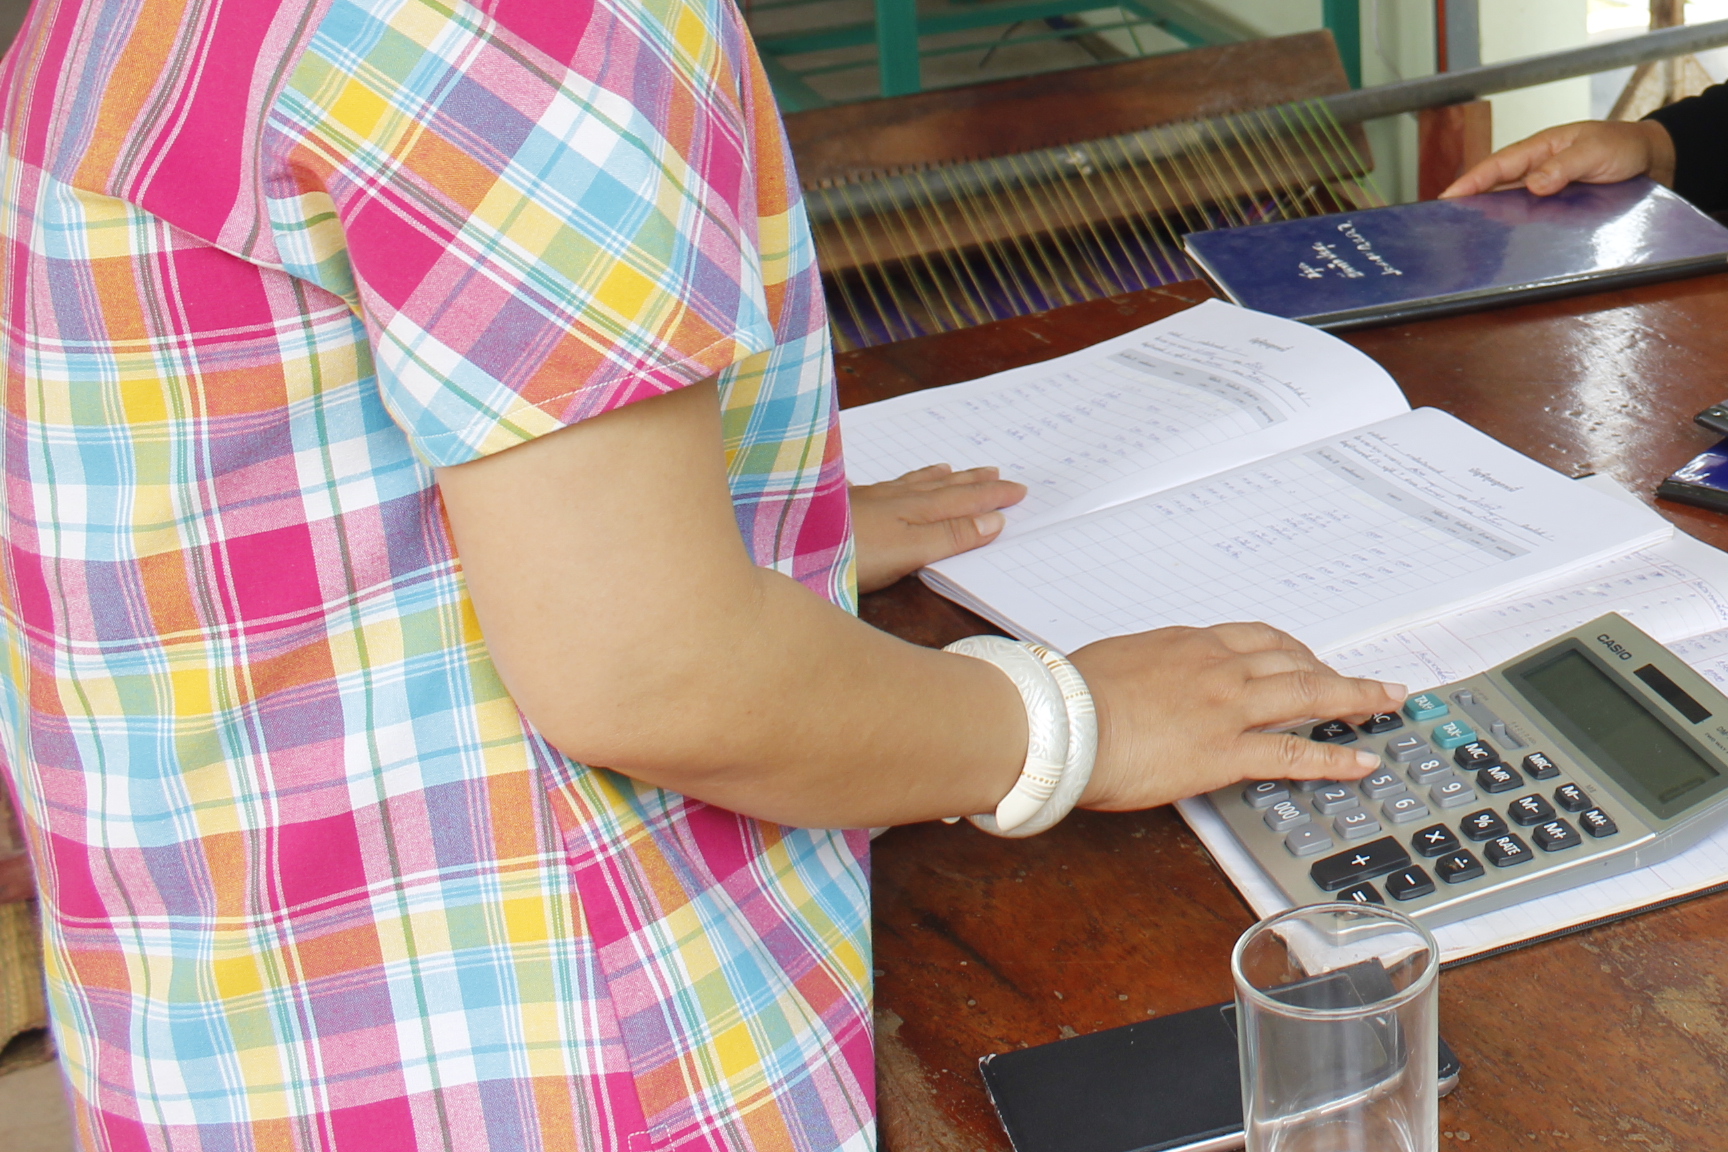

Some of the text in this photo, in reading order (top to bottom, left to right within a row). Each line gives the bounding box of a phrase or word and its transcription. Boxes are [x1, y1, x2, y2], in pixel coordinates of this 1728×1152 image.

[1597, 633, 1632, 661] CASIO
[1397, 737, 1417, 747] 7
[1465, 742, 1488, 760] MC
[1421, 759, 1440, 770] 8
[1529, 753, 1552, 770] MRC
[1371, 774, 1393, 786] 5
[1487, 765, 1510, 783] MR
[1325, 789, 1345, 800] 2
[1442, 782, 1462, 793] 9
[1273, 801, 1300, 820] 000
[1395, 798, 1415, 809] 6
[1346, 813, 1366, 823] 3
[1586, 810, 1607, 826] M+
[1543, 821, 1567, 840] M+
[1496, 836, 1521, 856] RATE
